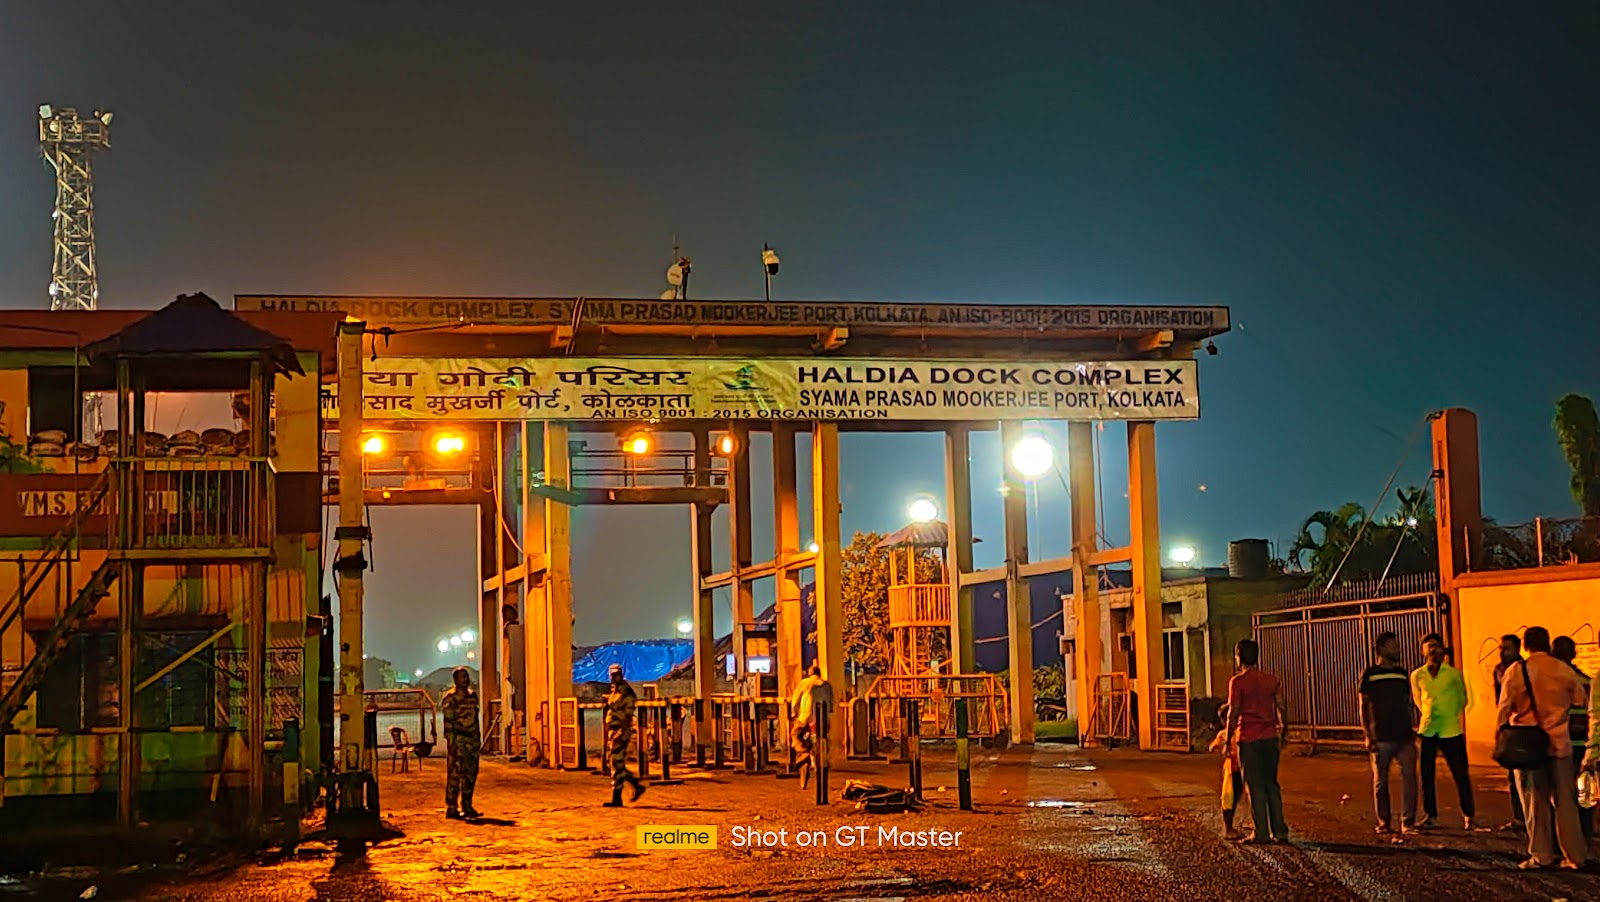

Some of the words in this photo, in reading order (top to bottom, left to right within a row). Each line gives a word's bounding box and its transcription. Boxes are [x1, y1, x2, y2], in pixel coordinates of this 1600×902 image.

[351, 301, 419, 318] DOCK
[620, 303, 696, 321] PRASAD
[701, 304, 800, 321] MOOKERJEE
[1097, 309, 1214, 326] ORGANISATION
[438, 366, 536, 387] गोदी
[555, 365, 692, 386] परिसर
[798, 367, 920, 384] HALDIA
[930, 367, 1021, 385] DOCK
[1031, 368, 1183, 386] COMPLEX
[426, 389, 507, 416] मुखर्जी
[581, 388, 693, 409] कोलकाता
[800, 388, 861, 407] SYAMA
[866, 389, 937, 407] PRASAD
[943, 390, 1048, 408] MOOKERJEE
[1108, 390, 1186, 408] KOLKATA
[592, 409, 616, 418] AN
[623, 409, 653, 418] ISO
[659, 408, 696, 418] 9001
[713, 409, 751, 418] 2015
[757, 409, 888, 419] ORGANISATION
